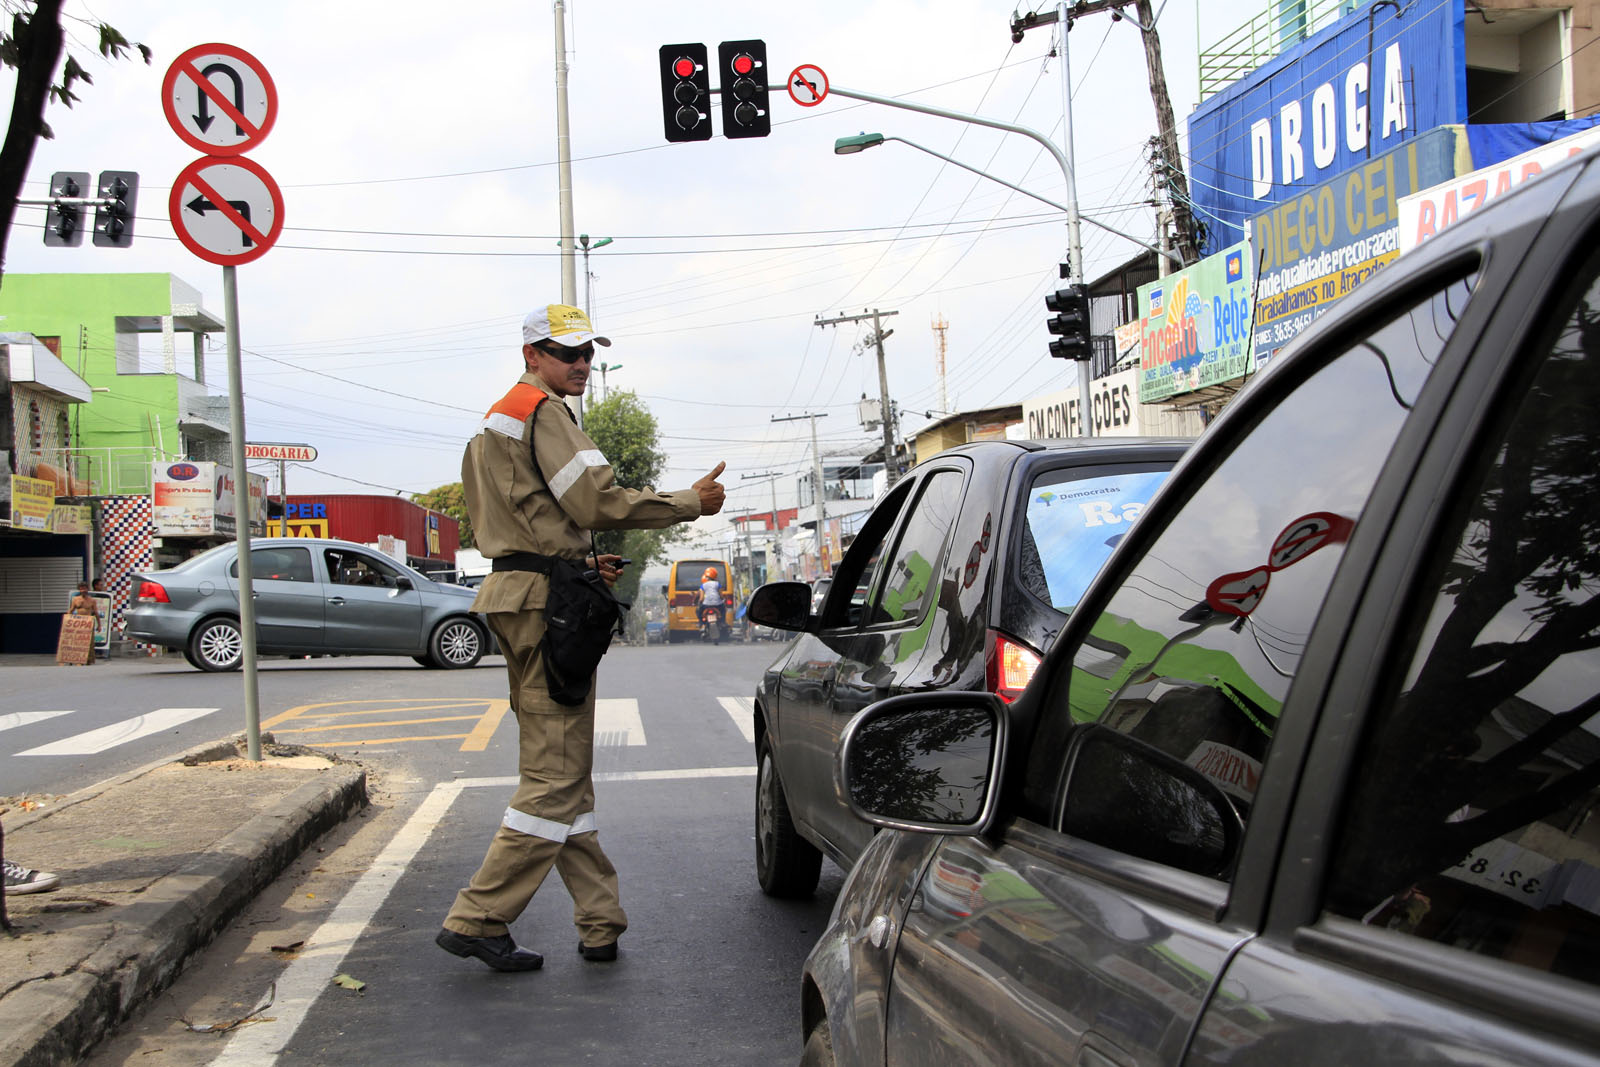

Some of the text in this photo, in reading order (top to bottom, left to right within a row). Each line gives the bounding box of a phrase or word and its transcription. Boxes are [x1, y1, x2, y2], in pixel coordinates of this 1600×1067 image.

[1251, 42, 1407, 199] DROGA
[1257, 186, 1335, 273] DIEGO
[1256, 285, 1318, 323] Trabalhamos
[1322, 280, 1335, 300] no
[1141, 311, 1197, 371] Encanto
[1214, 287, 1248, 348] Bebê
[1047, 382, 1130, 438] CONFEÇÕES
[244, 446, 310, 459] DROGARIA
[1060, 486, 1121, 501] Democratas
[65, 620, 92, 629] SOPA
